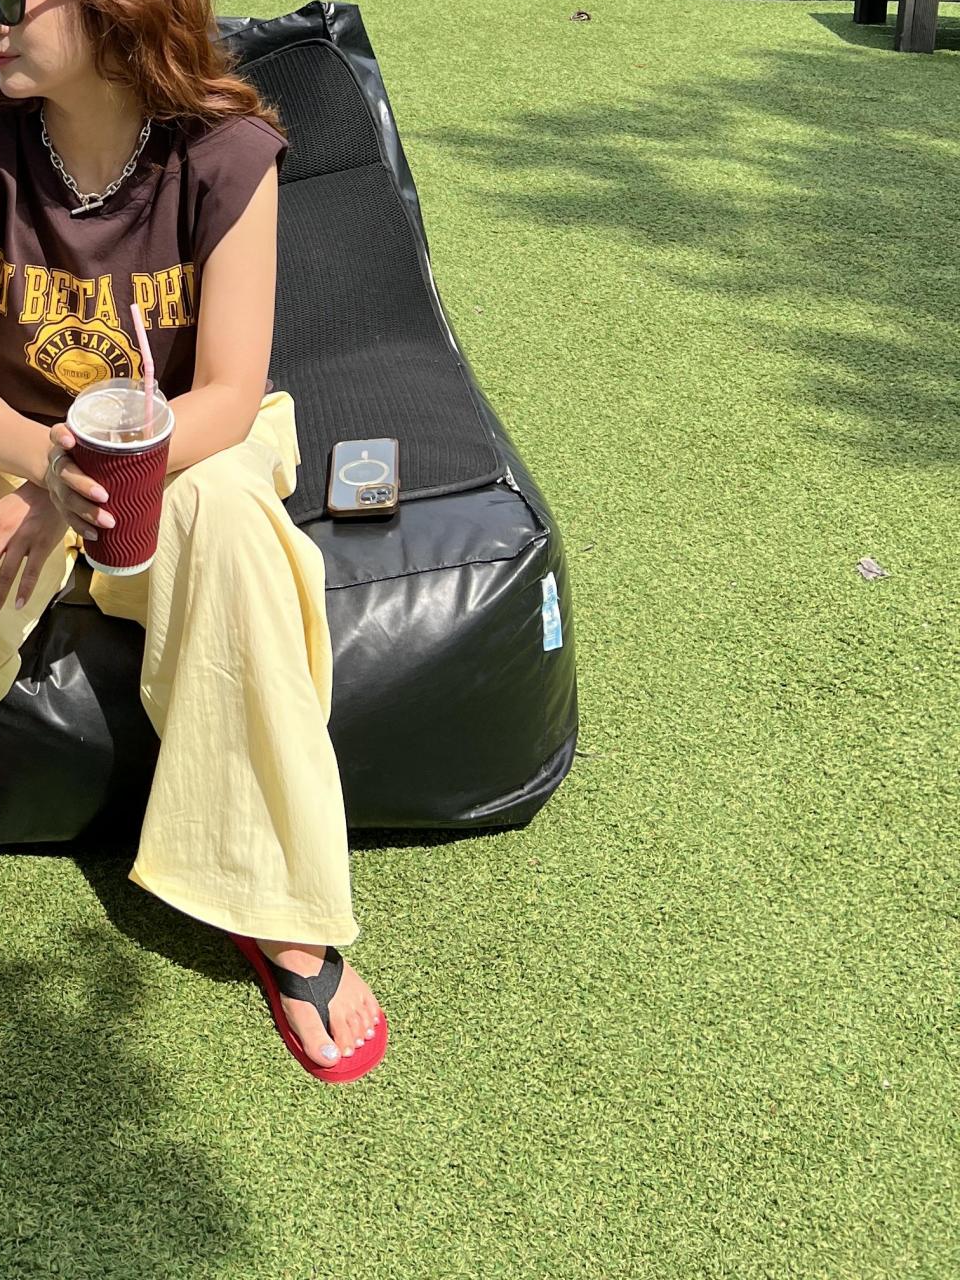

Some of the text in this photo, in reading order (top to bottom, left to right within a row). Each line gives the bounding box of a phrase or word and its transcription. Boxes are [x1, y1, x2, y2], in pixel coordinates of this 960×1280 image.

[19, 264, 120, 329] BETA
[131, 262, 195, 330] PHI
[38, 330, 128, 367] DATE PARTY
